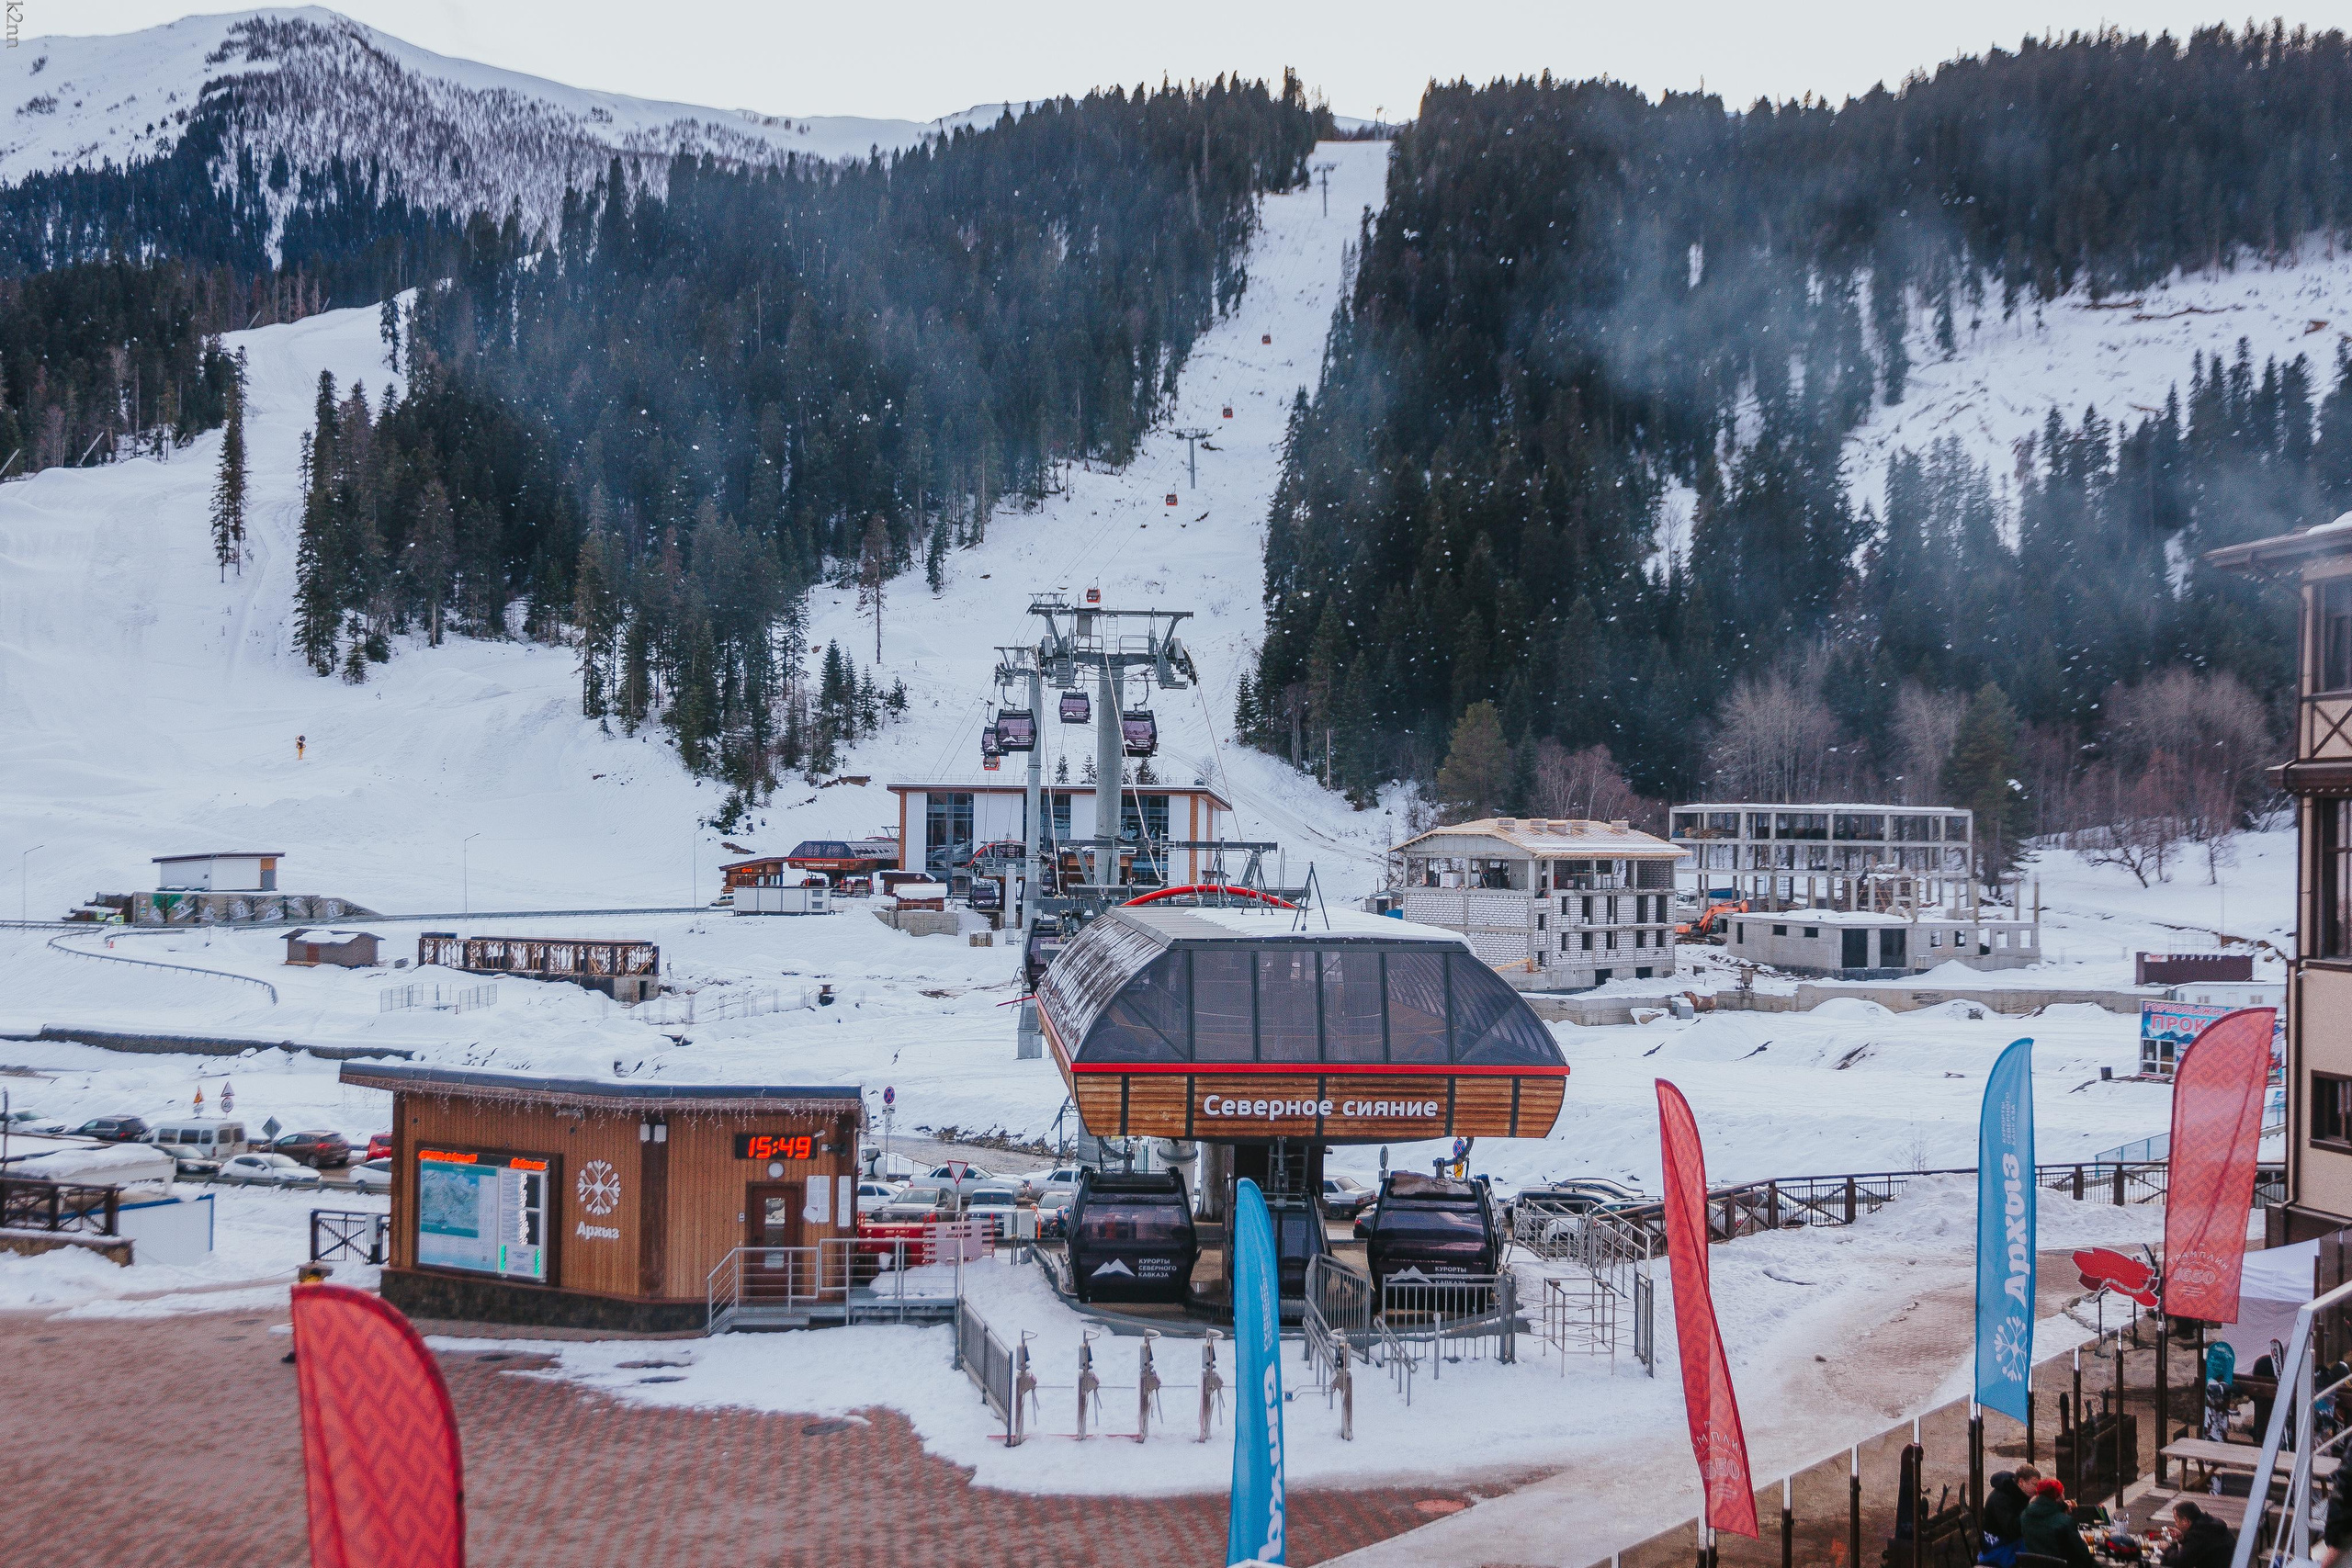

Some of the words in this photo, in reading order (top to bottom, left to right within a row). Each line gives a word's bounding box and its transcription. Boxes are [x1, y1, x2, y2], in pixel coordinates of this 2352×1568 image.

[1204, 1094, 1334, 1121] Северное
[1342, 1099, 1439, 1117] сияние
[748, 1135, 812, 1159] 15:49
[575, 1220, 620, 1240] Архыз
[2001, 1152, 2030, 1309] Архыз
[2166, 1250, 2230, 1270] ТРАМПЛИН
